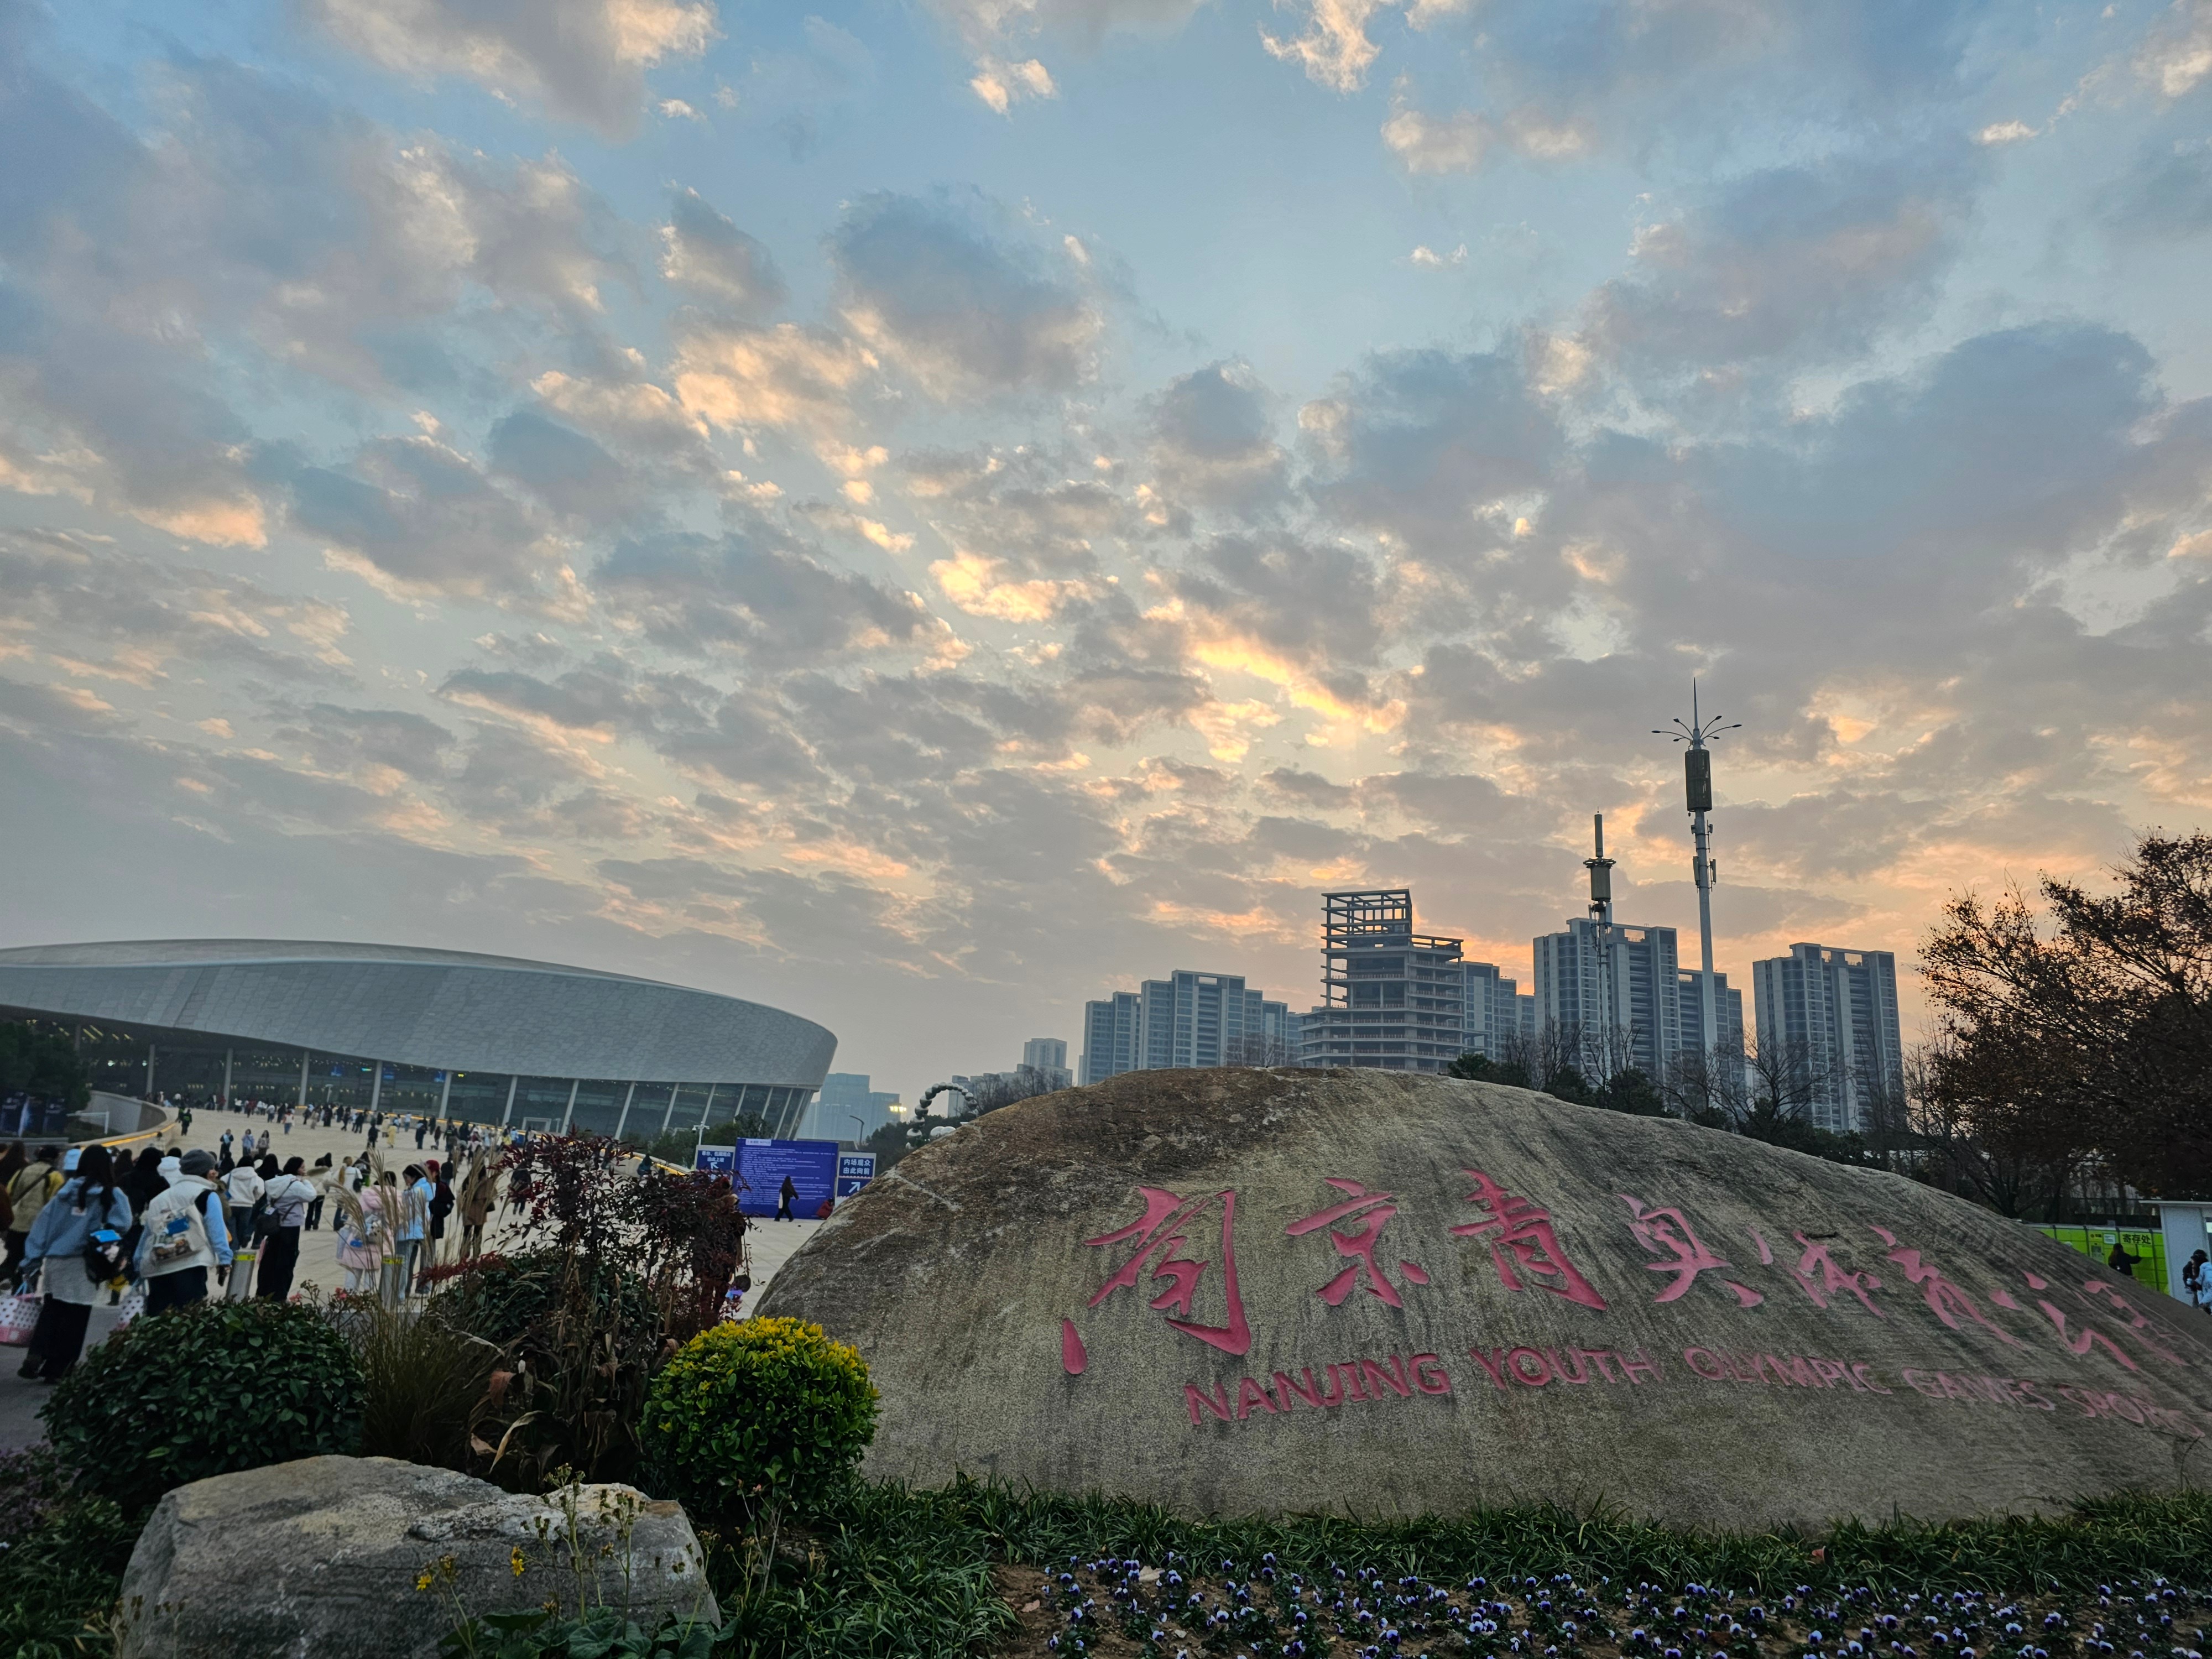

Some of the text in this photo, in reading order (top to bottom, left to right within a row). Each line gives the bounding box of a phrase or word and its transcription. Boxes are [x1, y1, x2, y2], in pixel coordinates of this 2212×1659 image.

[2122, 1234, 2151, 1244] 寄存处
[1185, 1353, 1451, 1425] NANJING
[1469, 1346, 1662, 1389] YOUTH
[1684, 1347, 1893, 1394] OLYMPIC
[1902, 1367, 2055, 1411] GAMES
